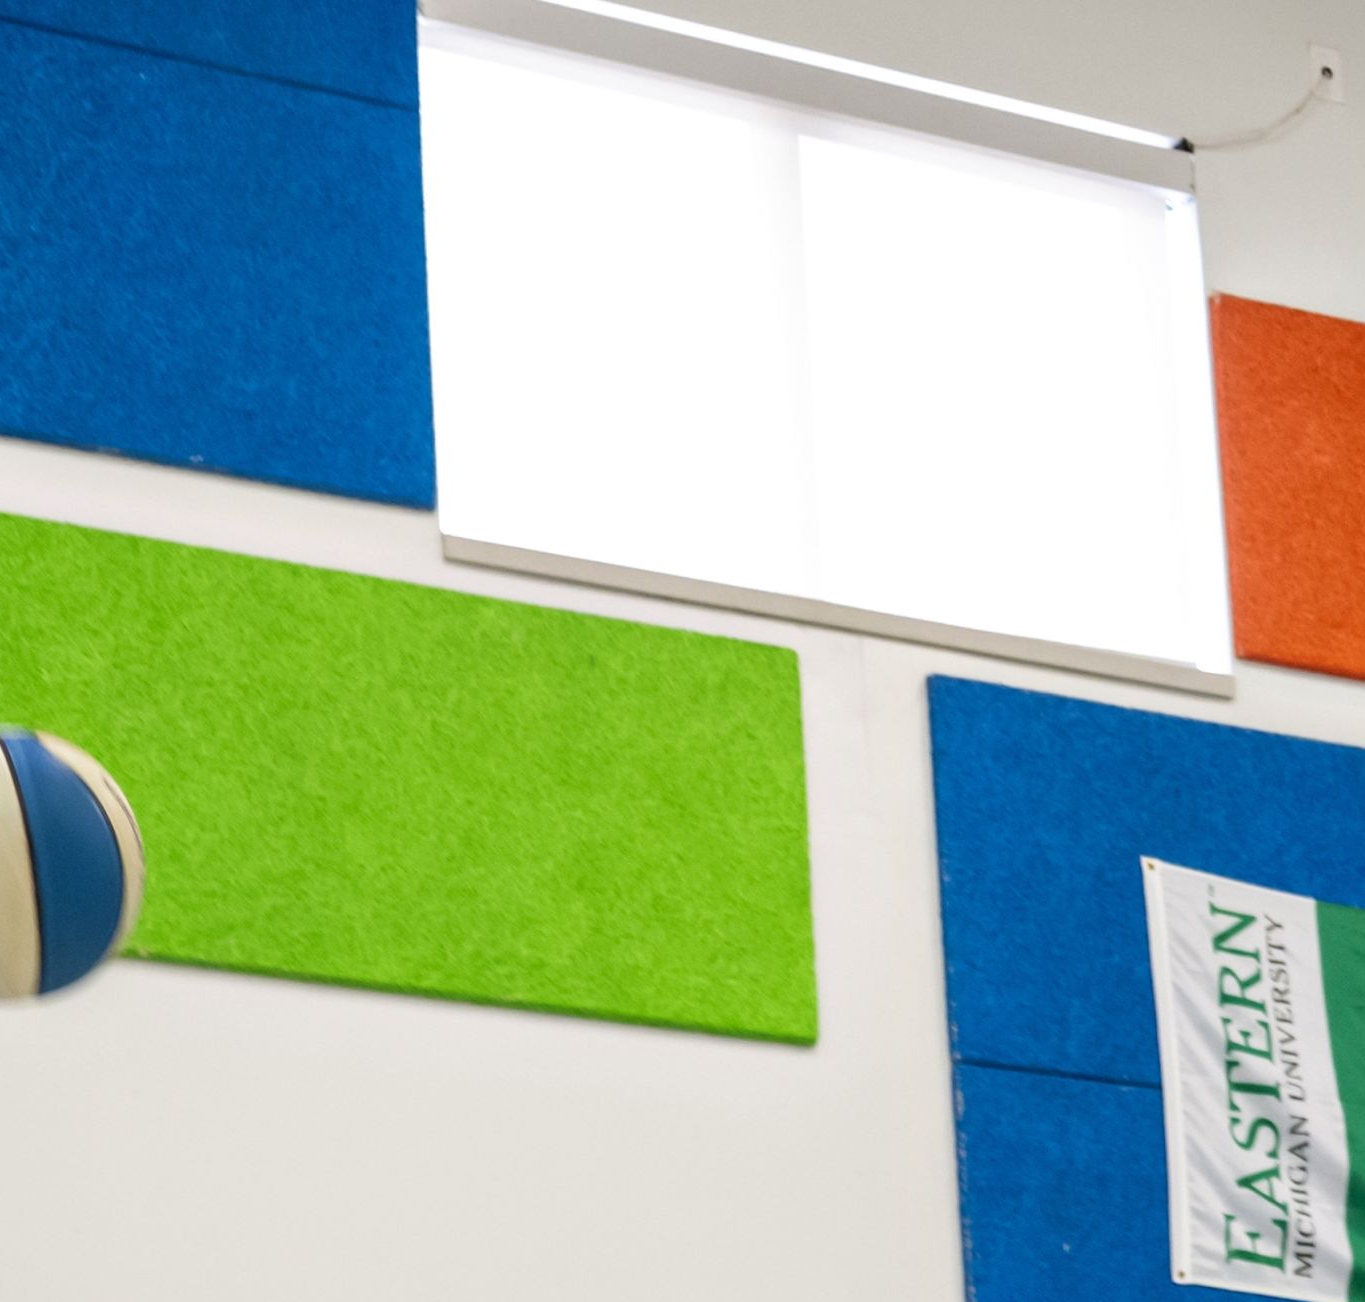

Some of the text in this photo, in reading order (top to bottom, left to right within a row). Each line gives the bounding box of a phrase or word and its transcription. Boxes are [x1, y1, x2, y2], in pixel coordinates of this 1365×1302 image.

[1208, 900, 1290, 1274] EASTERN
[1264, 913, 1317, 1279] MICHIGAN UNIVERSITY
